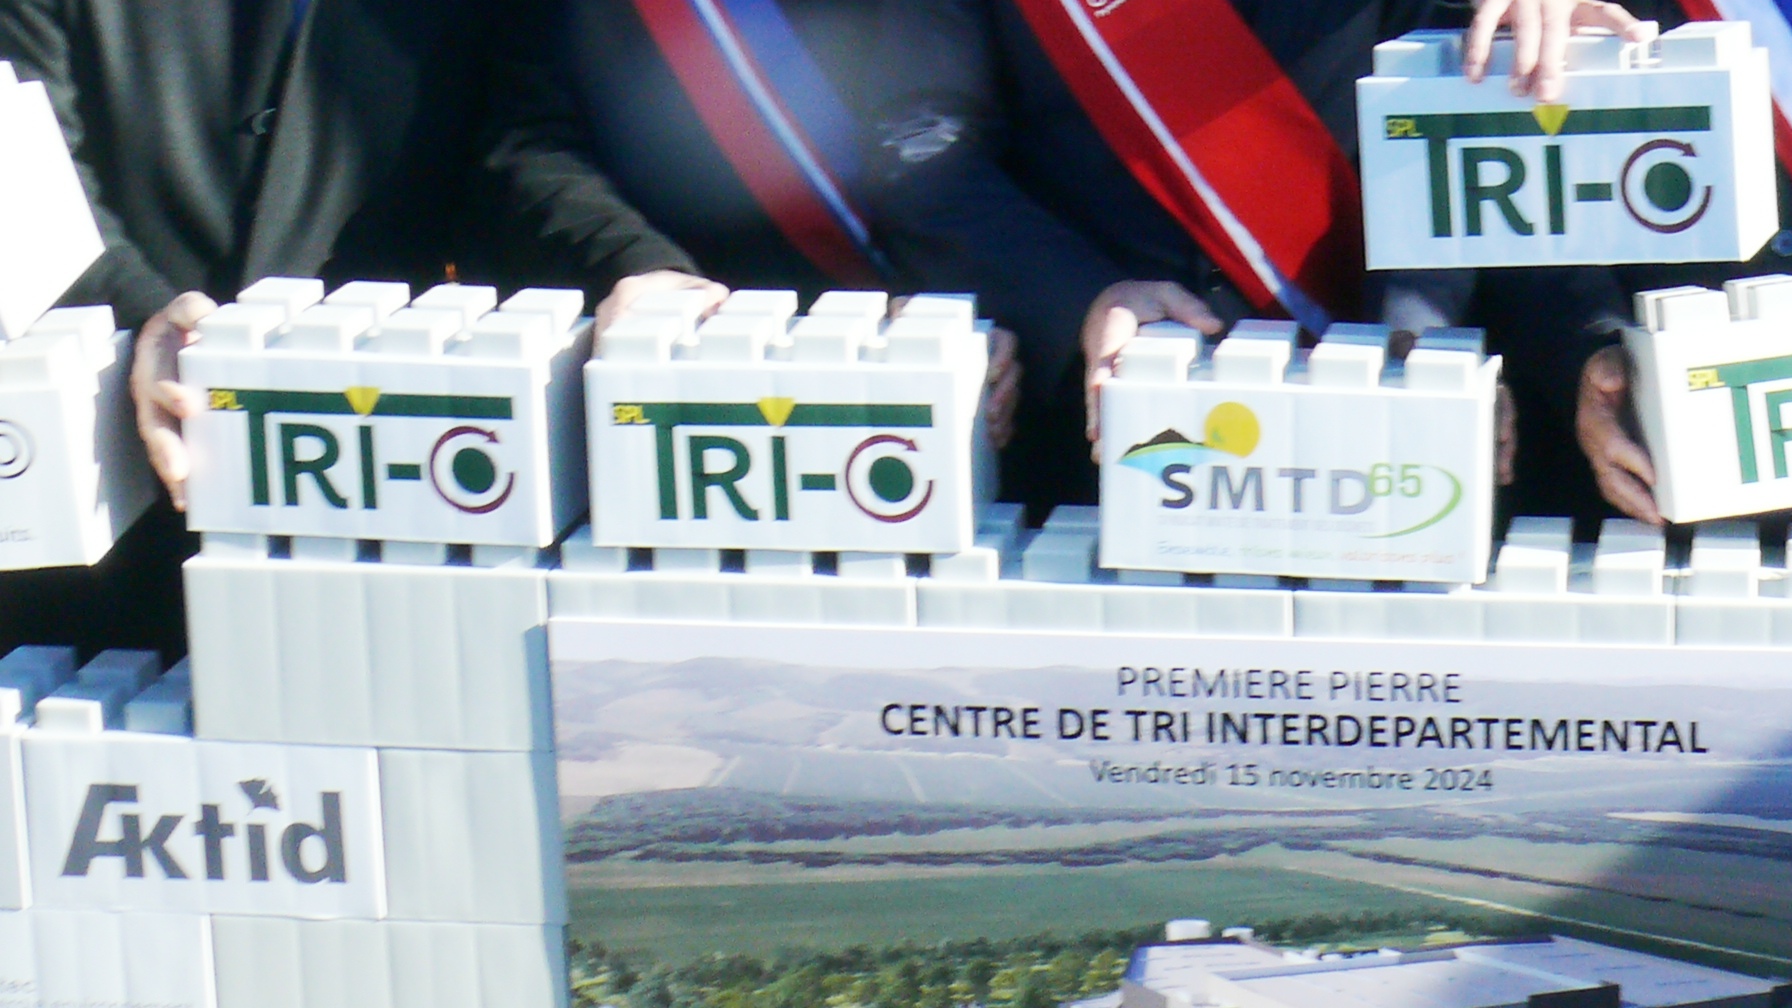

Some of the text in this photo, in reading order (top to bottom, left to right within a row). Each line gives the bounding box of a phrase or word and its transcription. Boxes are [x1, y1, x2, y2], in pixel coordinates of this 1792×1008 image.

[1118, 667, 1461, 703] PREMIERE PIERRE
[881, 704, 1709, 754] CENTRE DE TRI INTERDEPARTEMENTAL
[1090, 759, 1494, 791] Vendredi 15 novembre 2024
[60, 777, 346, 884] Aktid
